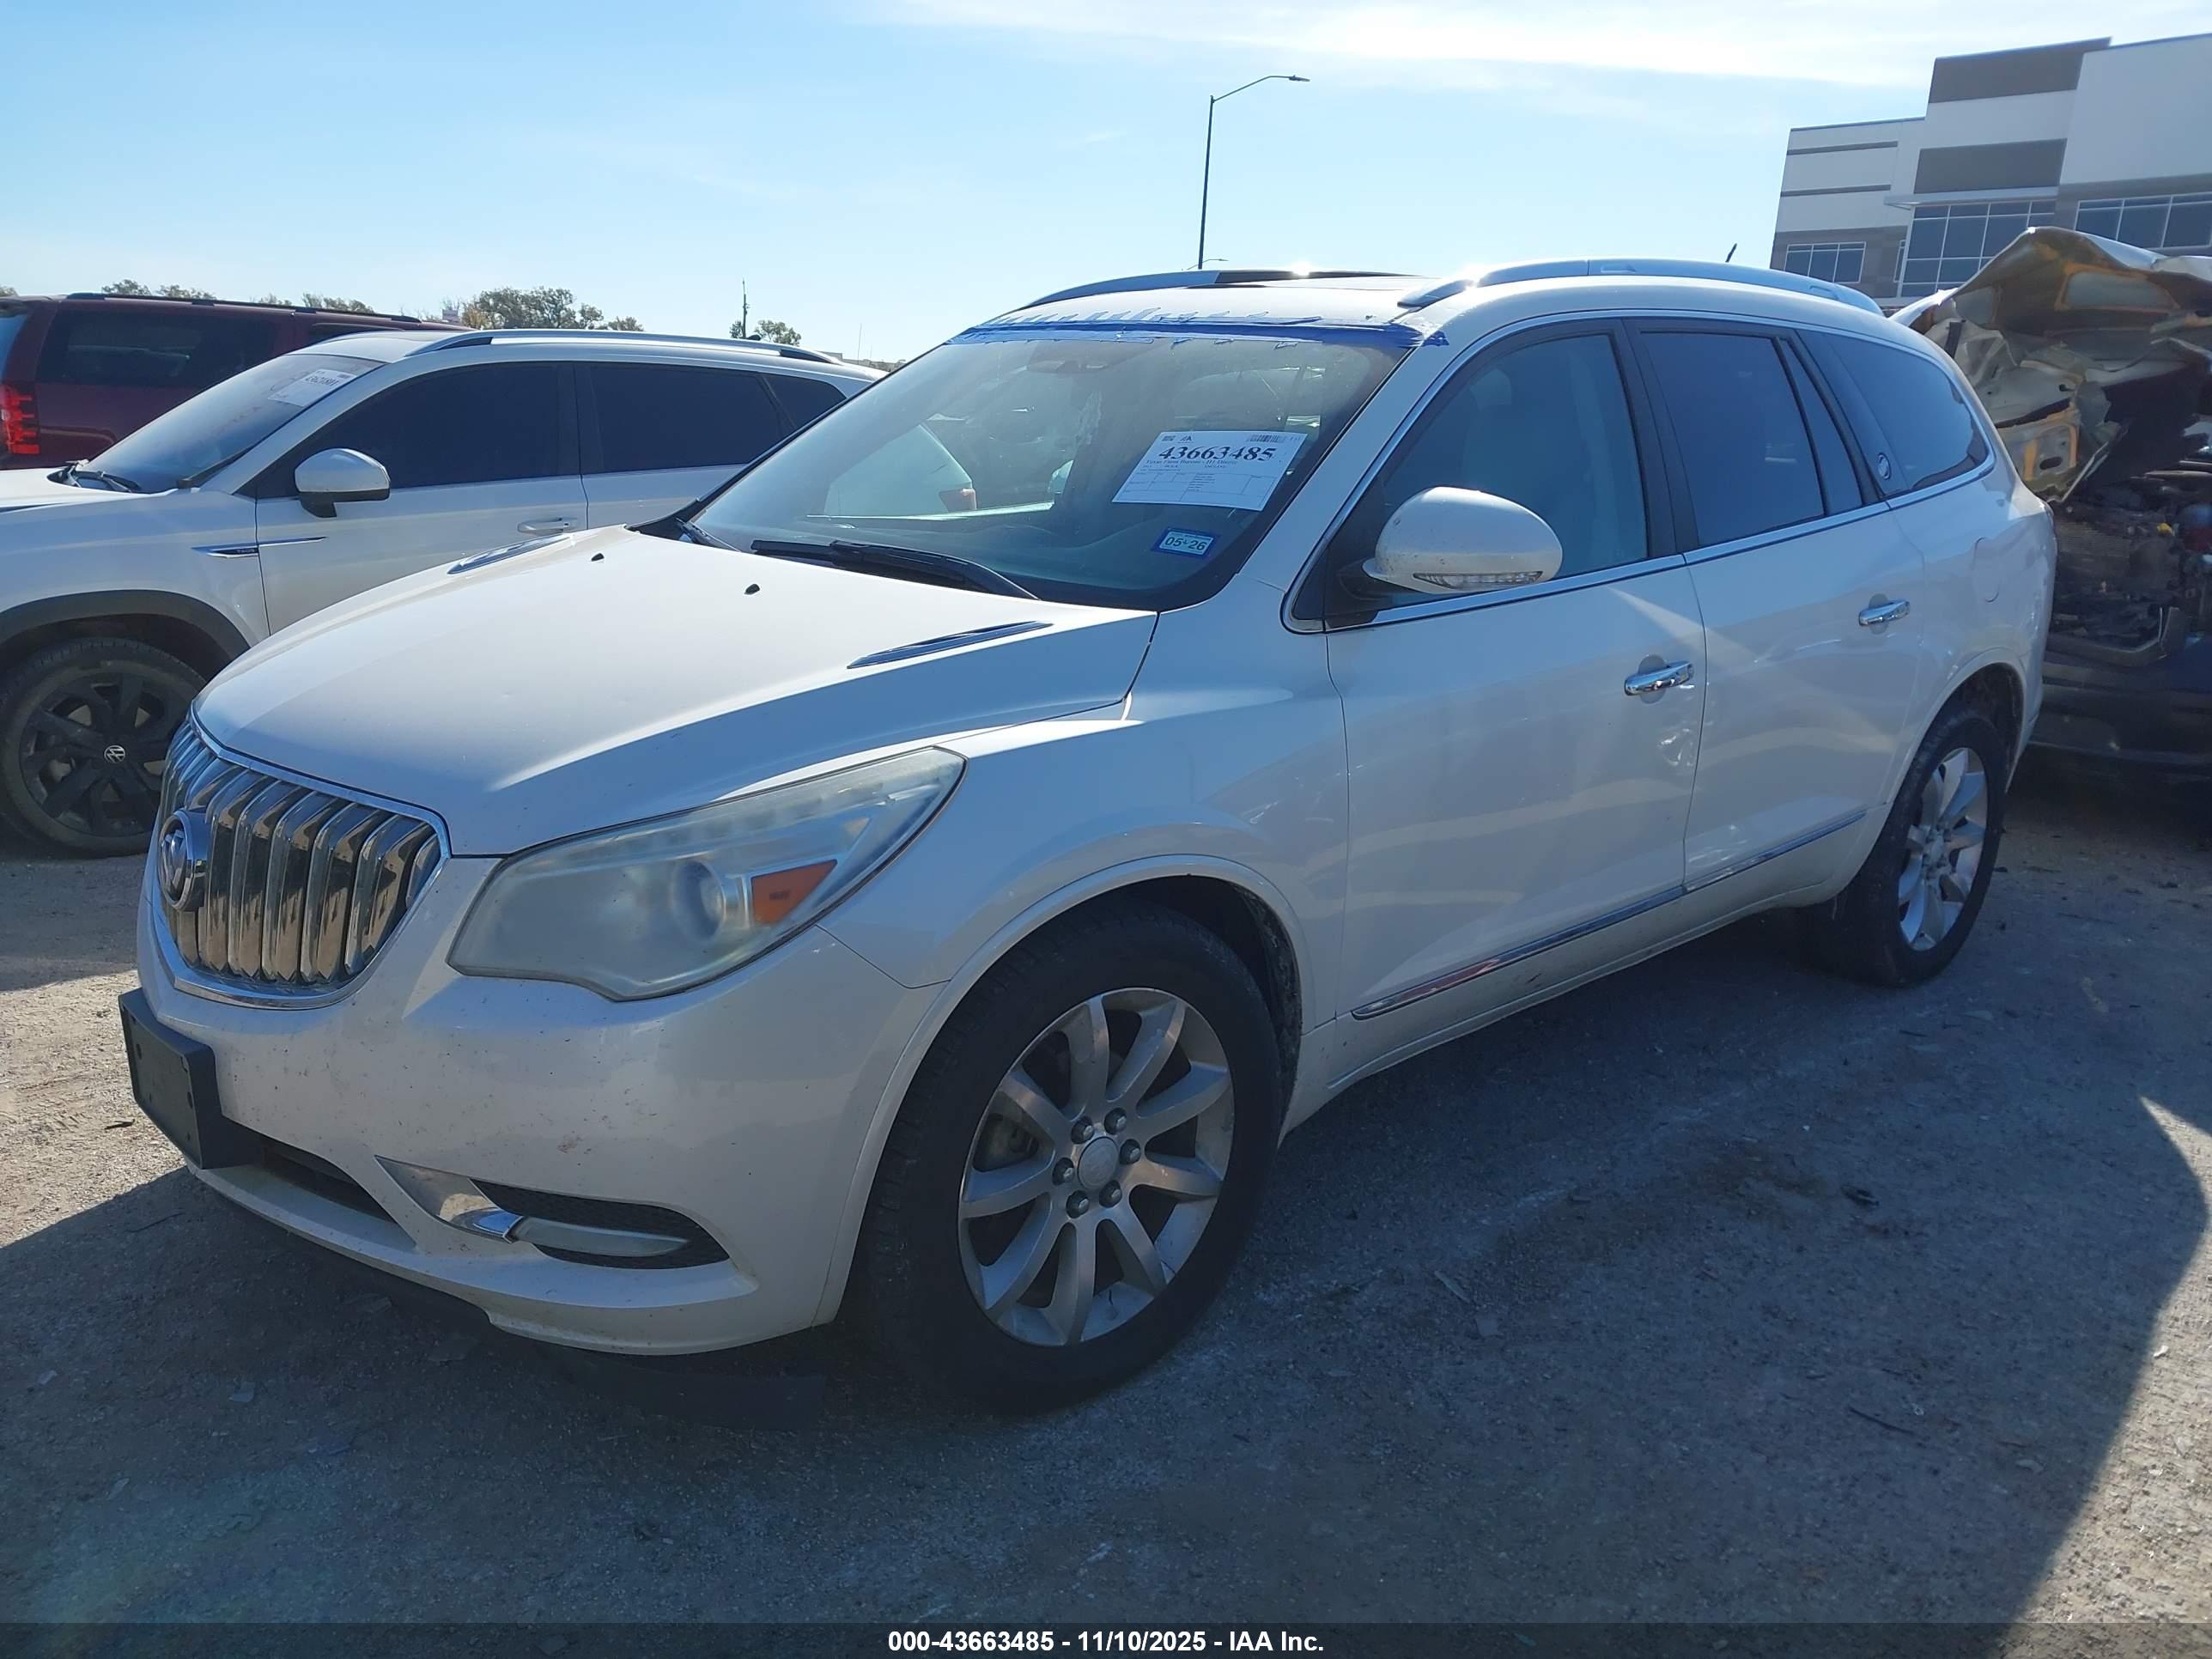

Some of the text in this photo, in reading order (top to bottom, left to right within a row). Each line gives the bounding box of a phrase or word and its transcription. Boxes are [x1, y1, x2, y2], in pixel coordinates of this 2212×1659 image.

[1159, 446, 1277, 461] 43663485
[1165, 537, 1207, 550] 05 26
